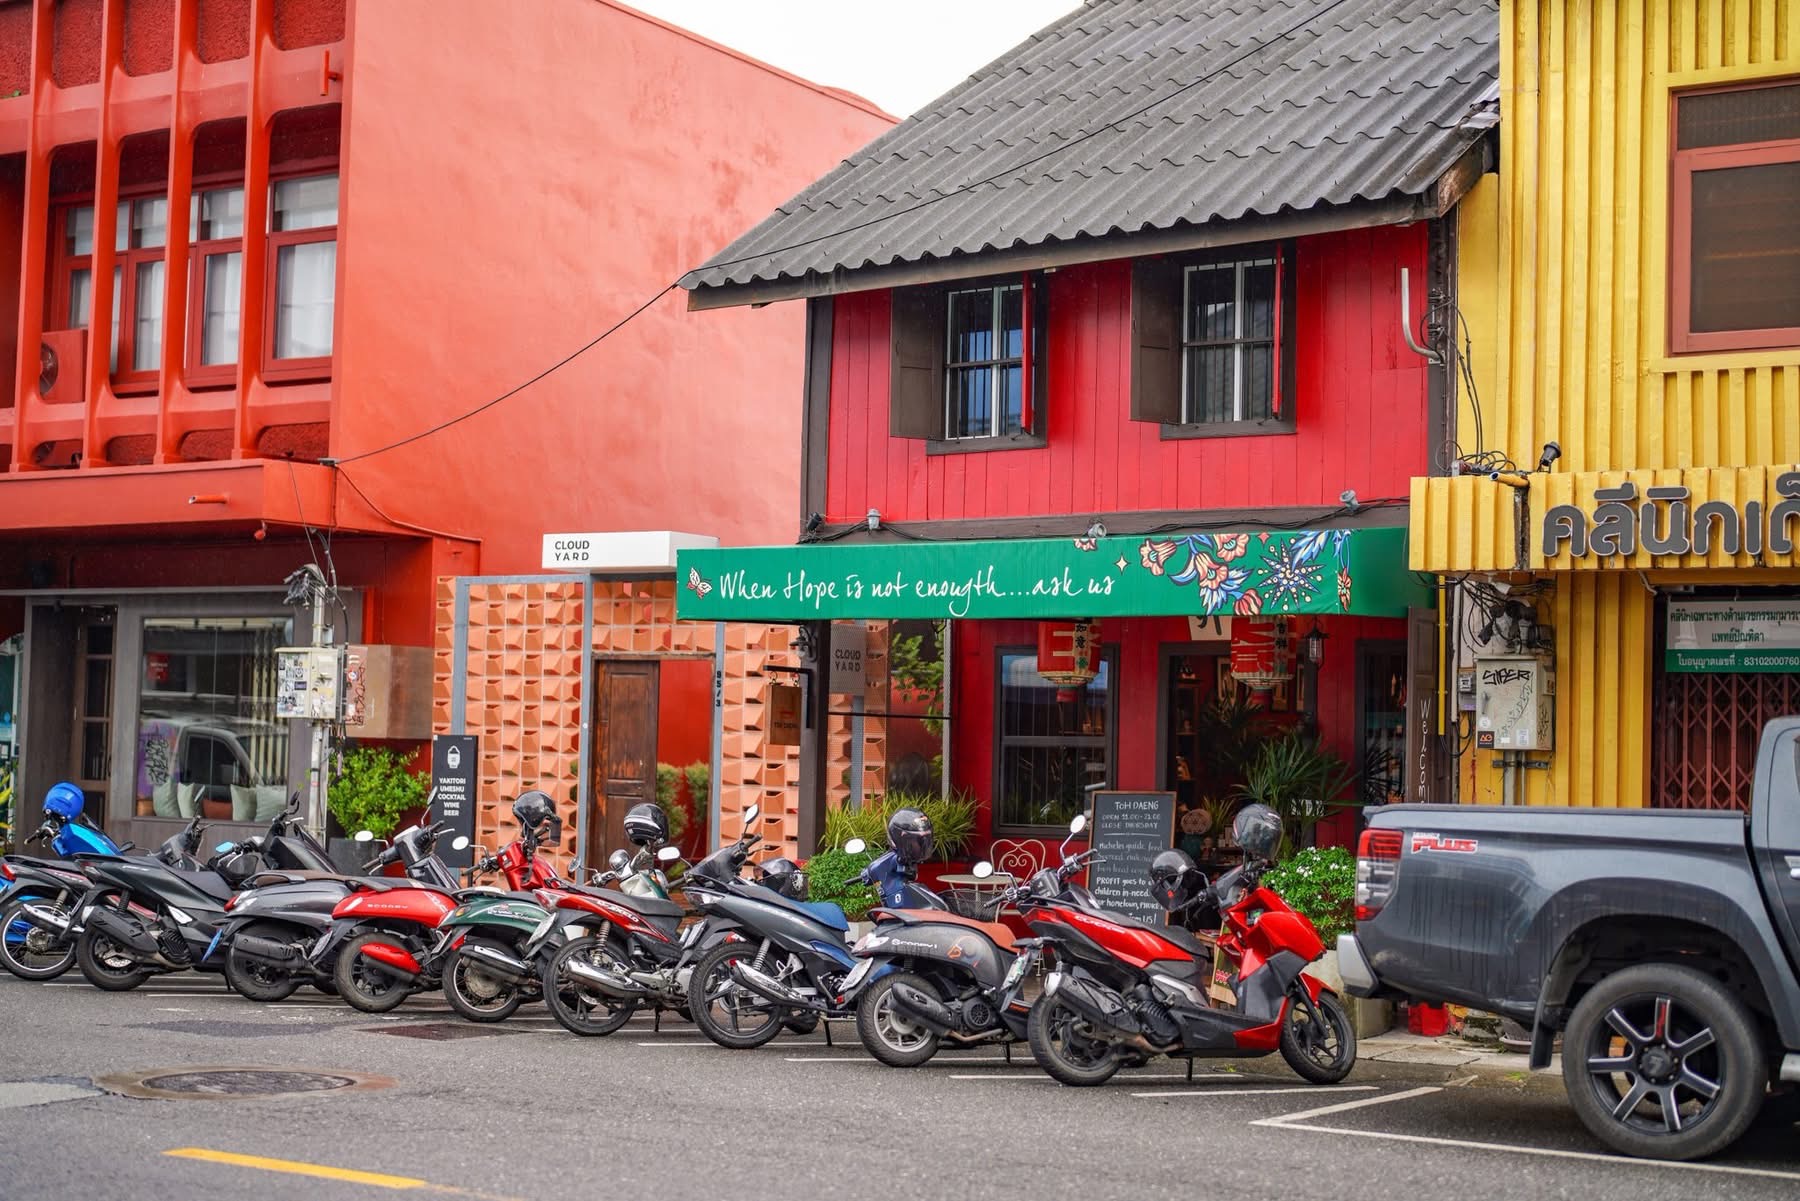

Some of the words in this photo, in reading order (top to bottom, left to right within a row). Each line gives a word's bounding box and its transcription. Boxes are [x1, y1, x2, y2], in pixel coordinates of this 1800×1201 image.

[554, 540, 590, 550] CLOUD
[554, 552, 590, 561] YARD
[720, 569, 777, 599] When
[783, 569, 839, 609] Hope
[845, 574, 865, 599] is
[872, 571, 909, 597] not
[1088, 575, 1115, 595] us
[834, 649, 861, 660] CLOUD
[834, 661, 861, 672] YARD
[1132, 800, 1160, 811] DAENG
[1096, 876, 1121, 886] PROFIT
[1094, 886, 1121, 897] children
